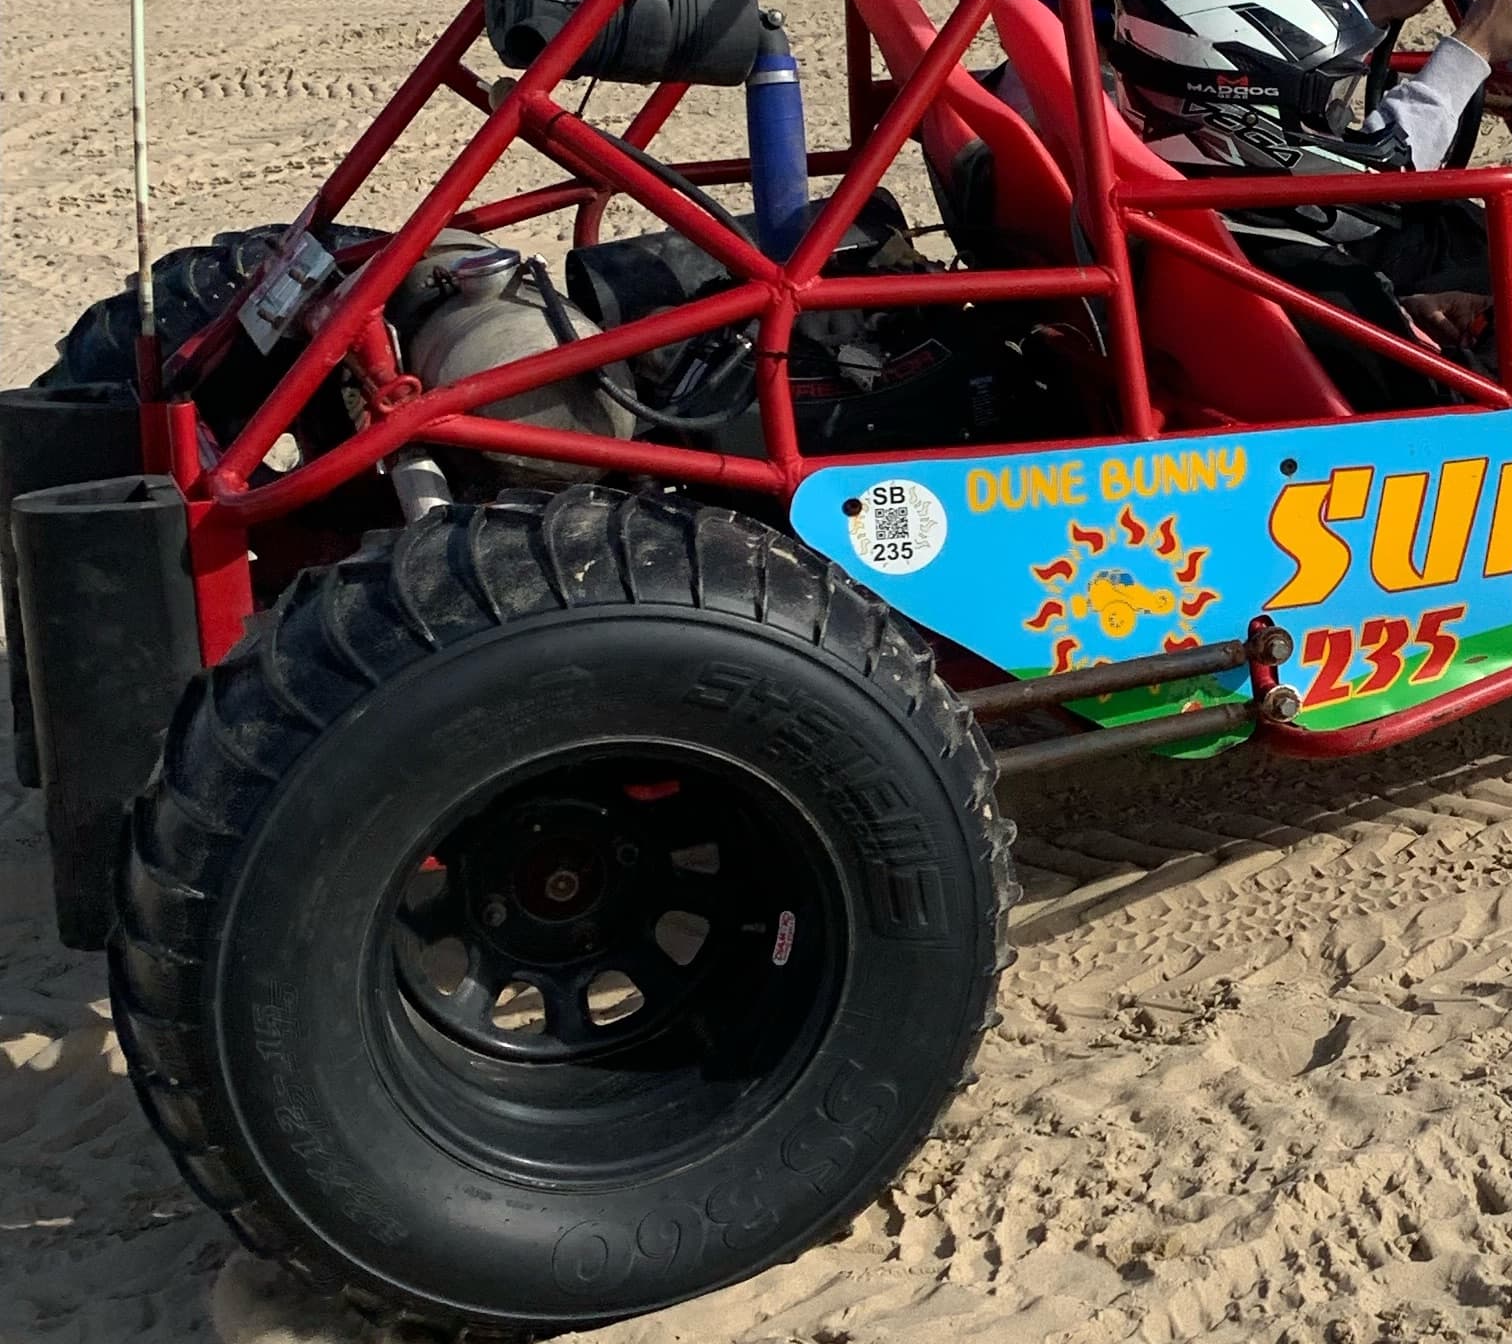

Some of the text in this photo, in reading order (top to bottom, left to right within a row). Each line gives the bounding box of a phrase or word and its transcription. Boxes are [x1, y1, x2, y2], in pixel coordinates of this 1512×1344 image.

[1186, 82, 1280, 97] MADDOG
[966, 445, 1247, 514] DUNE BUNNY
[872, 486, 906, 506] SB
[872, 541, 914, 563] 235
[1299, 603, 1467, 710] 235
